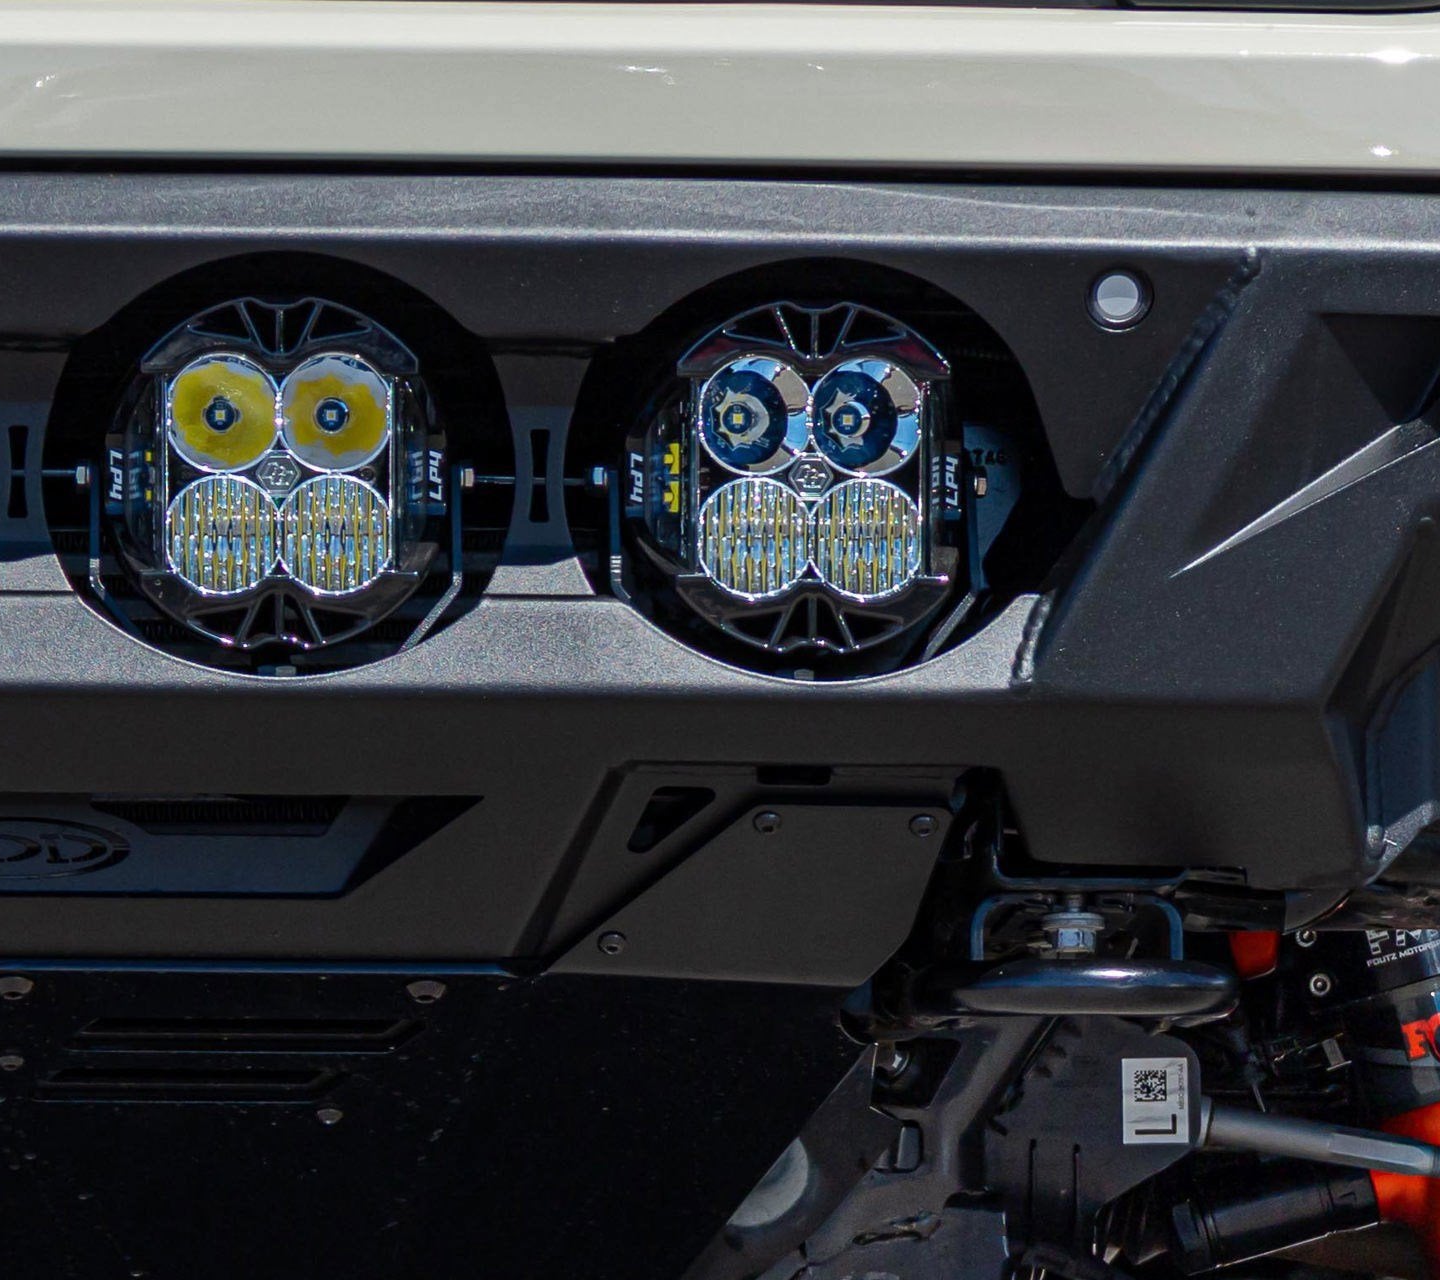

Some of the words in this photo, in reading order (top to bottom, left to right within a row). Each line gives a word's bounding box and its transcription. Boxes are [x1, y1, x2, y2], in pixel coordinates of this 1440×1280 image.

[109, 450, 123, 500] LP4
[429, 450, 442, 500] LP4
[630, 452, 643, 503] LP4
[945, 456, 958, 506] LP4
[1366, 952, 1398, 968] FOUTZ
[1135, 1113, 1177, 1135] L
